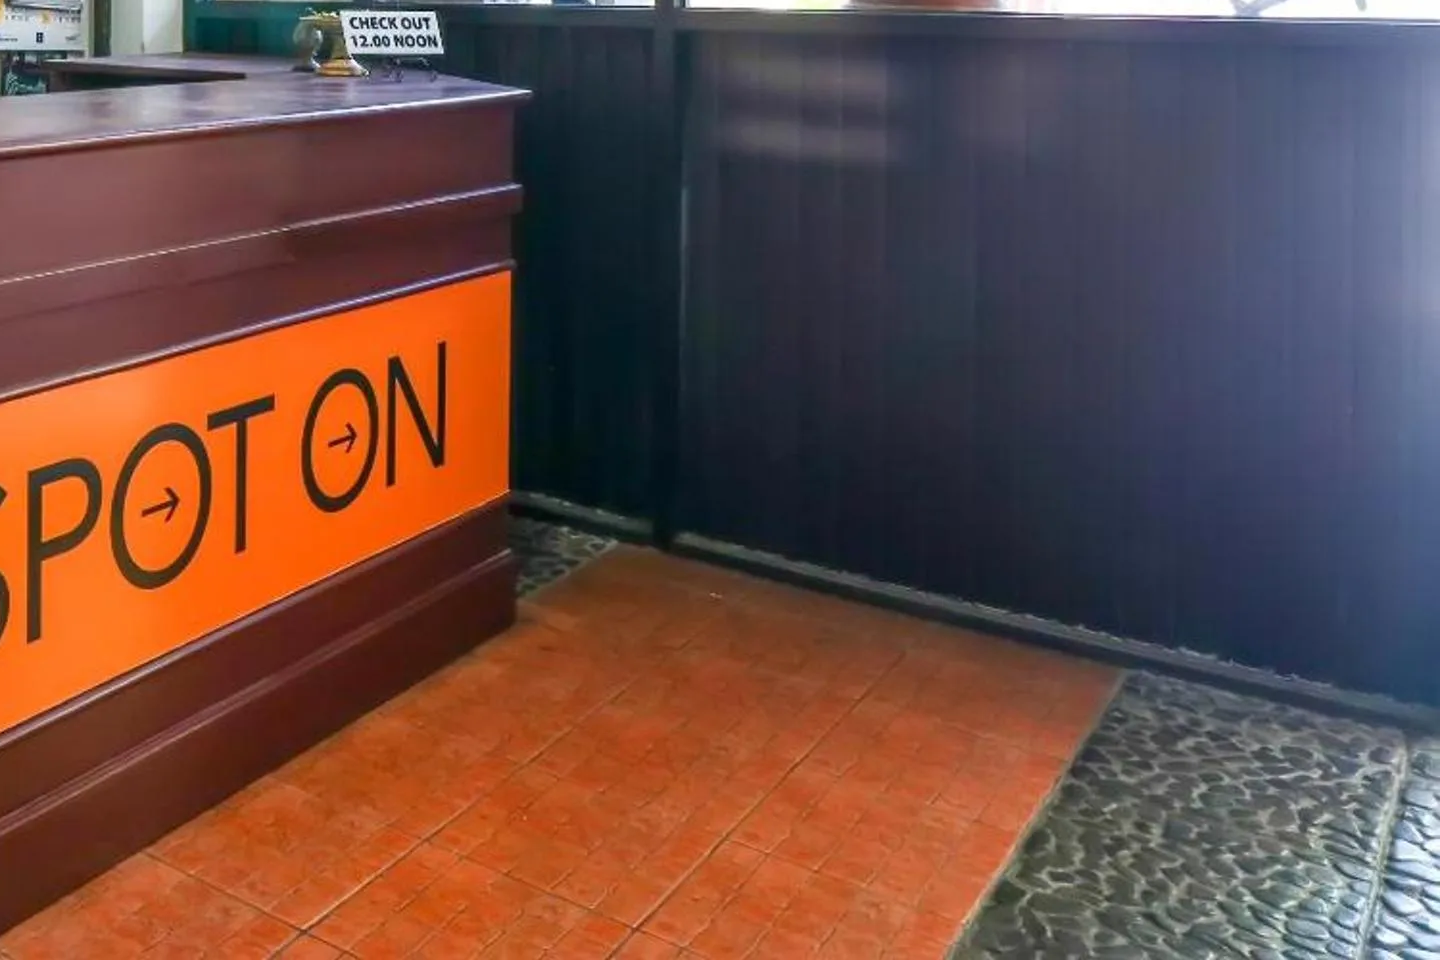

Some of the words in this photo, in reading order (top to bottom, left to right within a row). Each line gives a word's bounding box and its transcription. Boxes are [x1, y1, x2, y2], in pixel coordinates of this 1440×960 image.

[349, 16, 399, 30] CHECK
[401, 16, 432, 30] OUT
[351, 34, 391, 48] 12.00
[394, 34, 439, 48] NOON
[300, 340, 447, 514] ON
